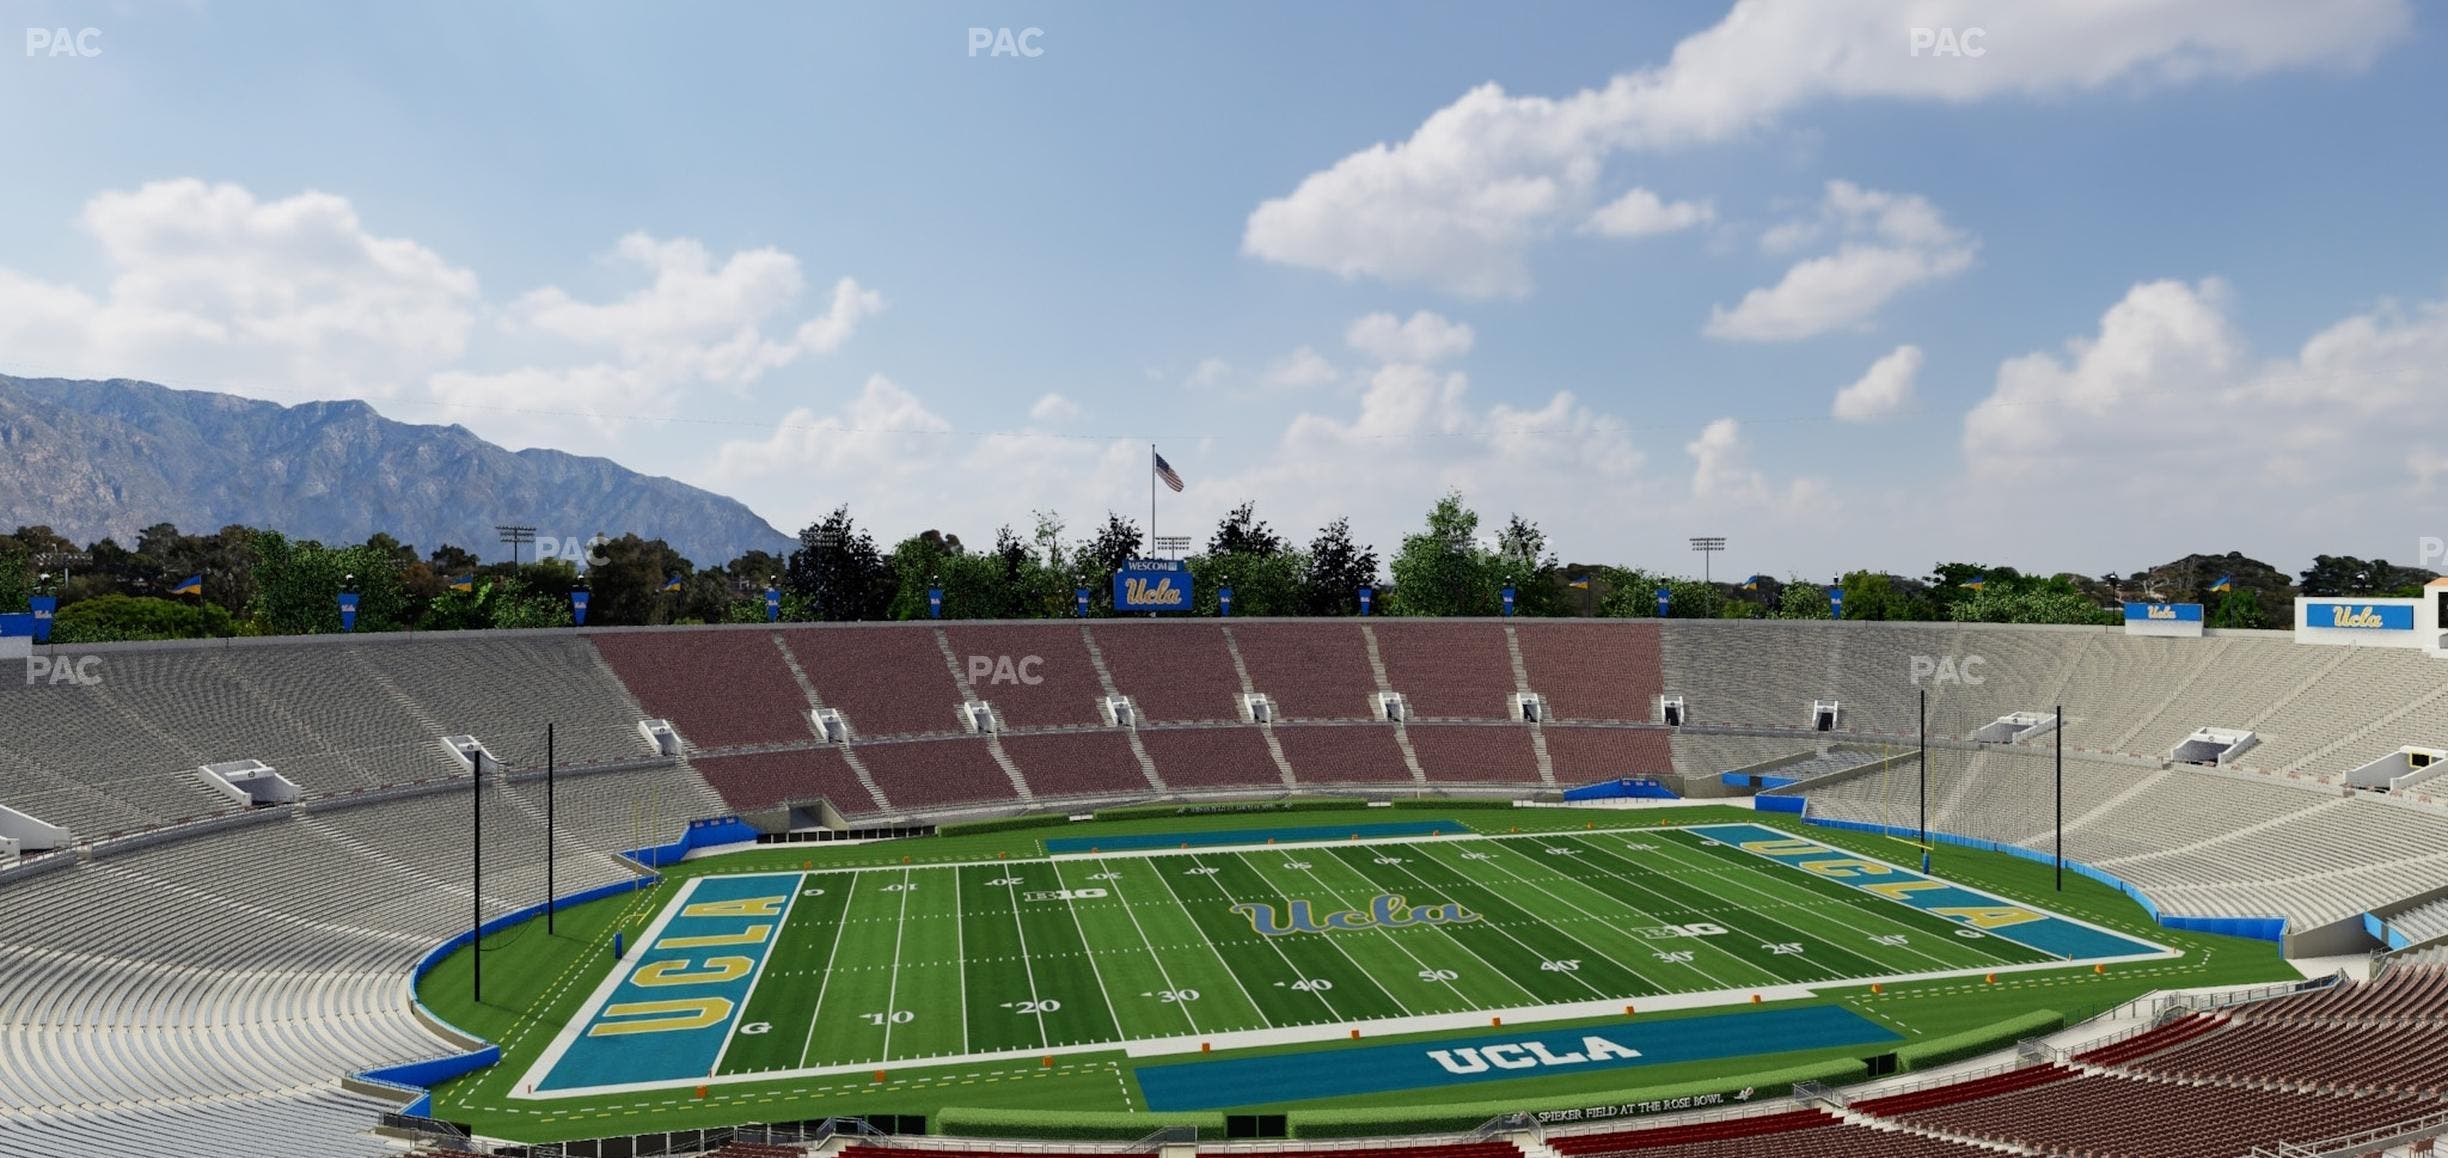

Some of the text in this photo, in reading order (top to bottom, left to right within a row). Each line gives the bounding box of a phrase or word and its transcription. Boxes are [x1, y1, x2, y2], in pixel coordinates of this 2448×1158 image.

[1128, 561, 1167, 571] WESCOM
[1125, 578, 1182, 604] Ucla
[2333, 605, 2382, 628] Ucla
[1739, 839, 2050, 929] UCLA
[1229, 893, 1484, 937] Ucla
[1761, 942, 1801, 956] 20
[1652, 951, 1690, 964] 30
[587, 895, 787, 1037] UCLA
[1540, 959, 1578, 973] 40
[1418, 969, 1459, 982] 50
[1290, 978, 1333, 992] 40
[1156, 988, 1201, 1003] 30
[1015, 999, 1062, 1014] 20
[869, 1010, 915, 1026] 10
[740, 1021, 773, 1035] G
[1427, 1035, 1643, 1075] UCLA
[1538, 1093, 1724, 1123] SPIEKER FIELD AT THE ROSE BOWL
